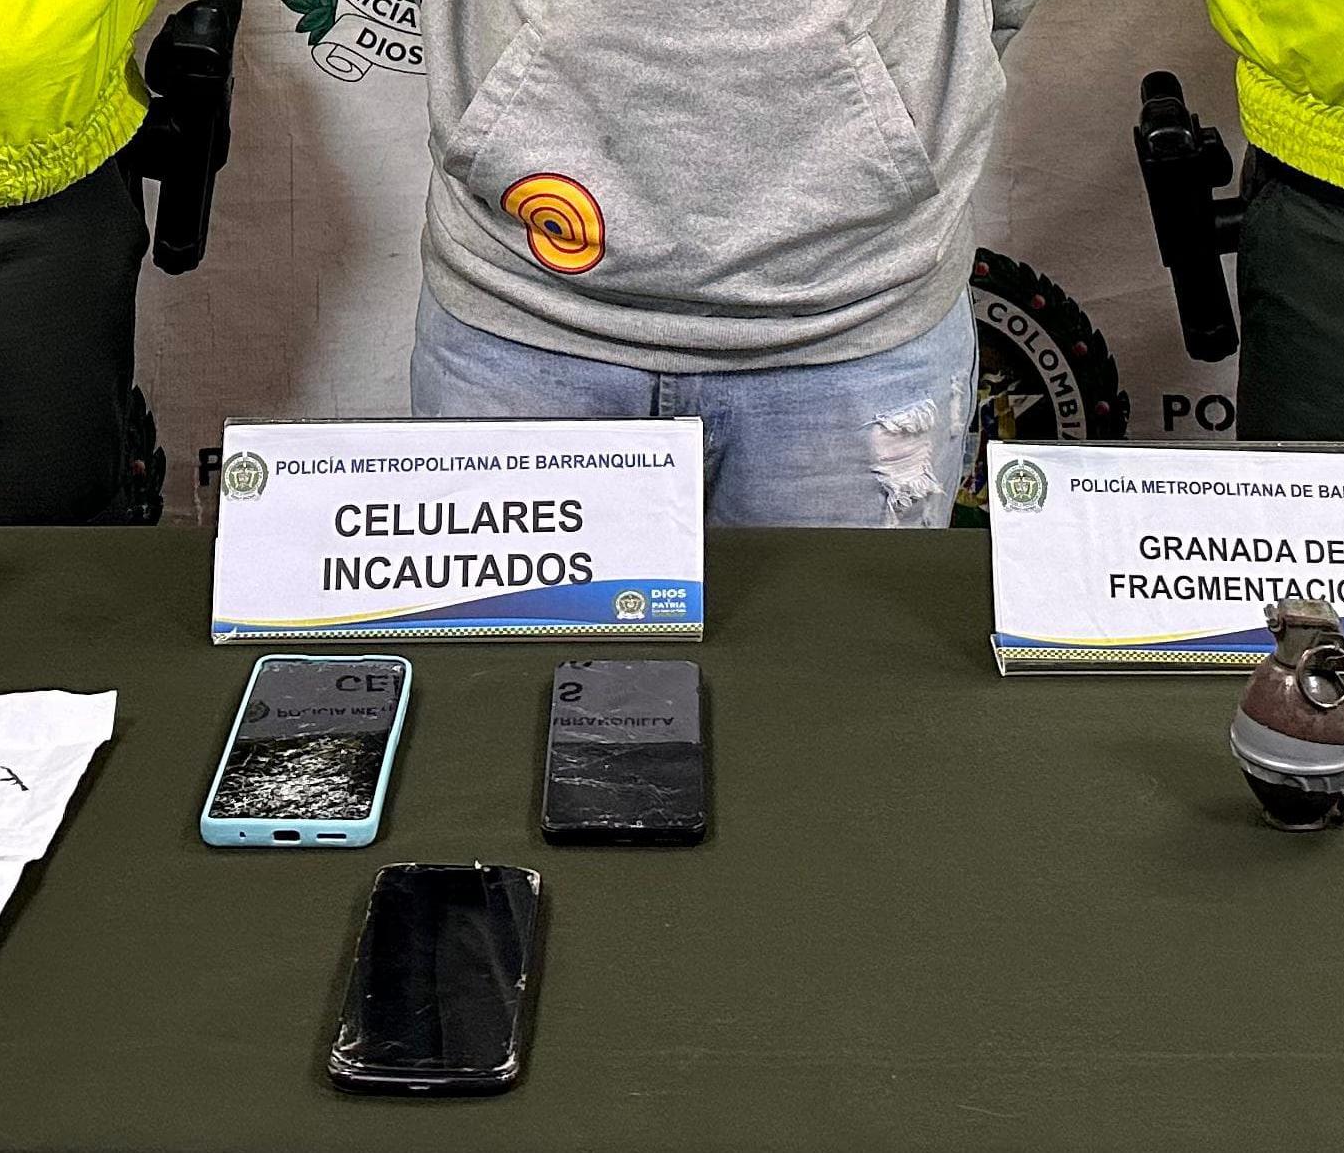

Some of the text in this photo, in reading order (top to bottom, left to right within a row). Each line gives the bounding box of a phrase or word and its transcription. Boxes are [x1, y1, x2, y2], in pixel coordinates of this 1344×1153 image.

[355, 26, 424, 65] DIOS
[275, 453, 676, 475] POLICÍA METROPOLITANA DE BARRANQUILLA
[1070, 476, 1137, 495] POLICÍA
[1141, 479, 1286, 499] METROPOLITANA
[1290, 484, 1314, 499] DE
[334, 500, 584, 538] CELULARES
[1139, 535, 1297, 564] GRANADA
[322, 552, 594, 590] INCAUTADOS
[651, 589, 687, 599] DIOS
